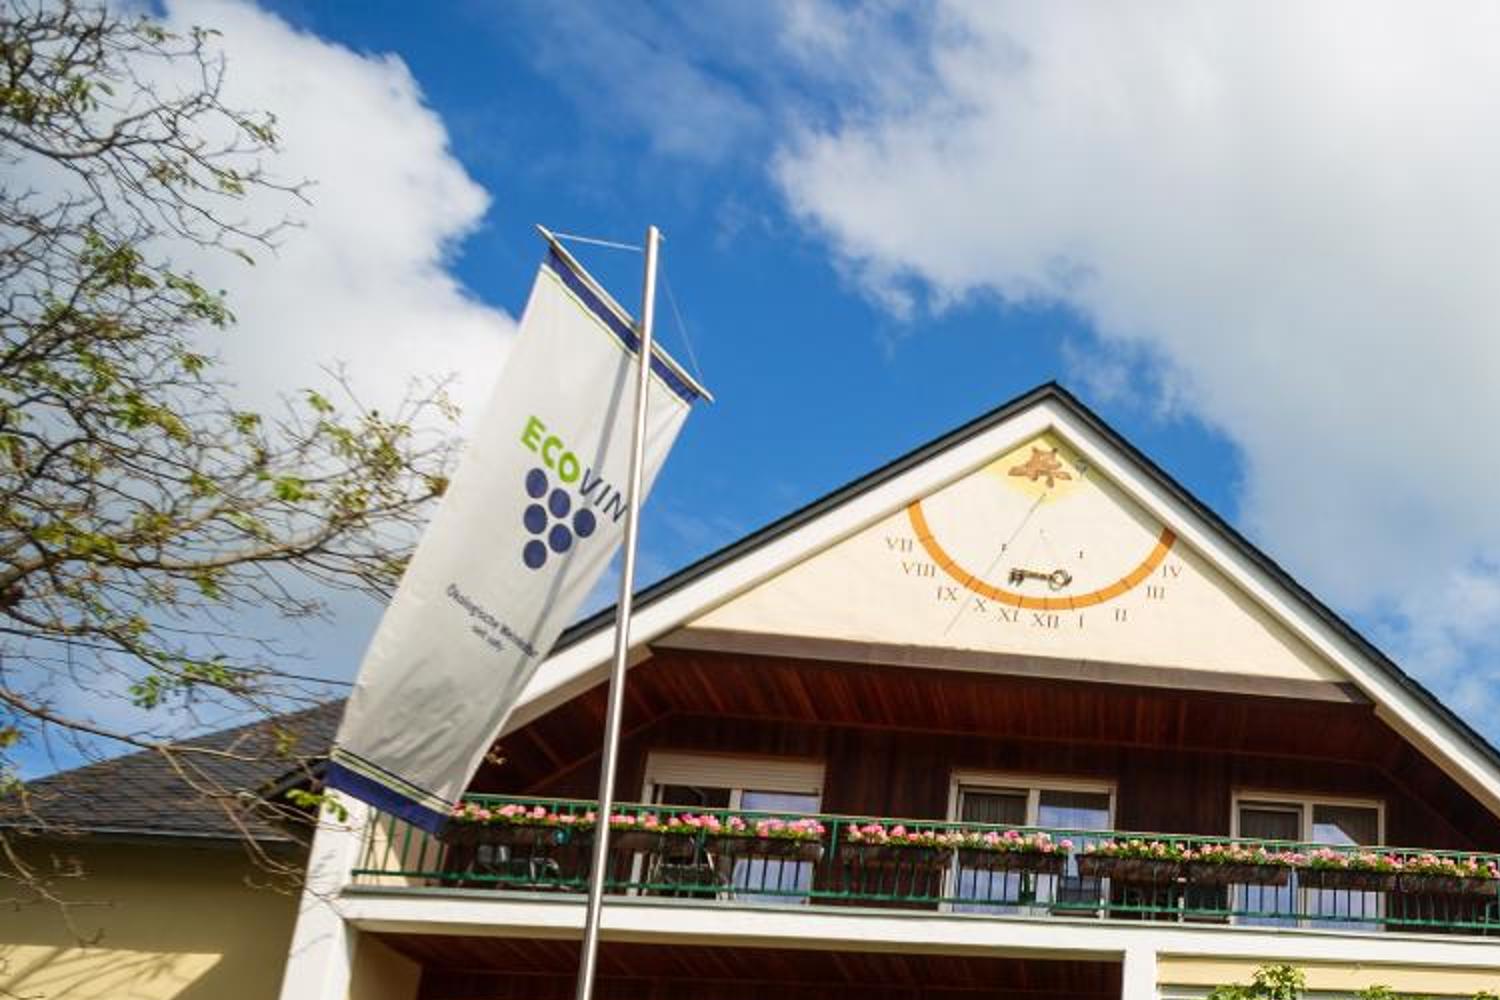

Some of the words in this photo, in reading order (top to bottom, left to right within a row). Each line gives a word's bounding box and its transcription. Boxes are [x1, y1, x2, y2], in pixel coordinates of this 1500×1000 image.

[520, 415, 628, 523] ECOVIN
[885, 536, 913, 552] VII
[902, 561, 936, 577] VIII
[937, 585, 959, 601] IX
[973, 597, 988, 612] X
[997, 608, 1019, 622] XI
[1031, 613, 1060, 629] XII
[1146, 585, 1166, 600] III
